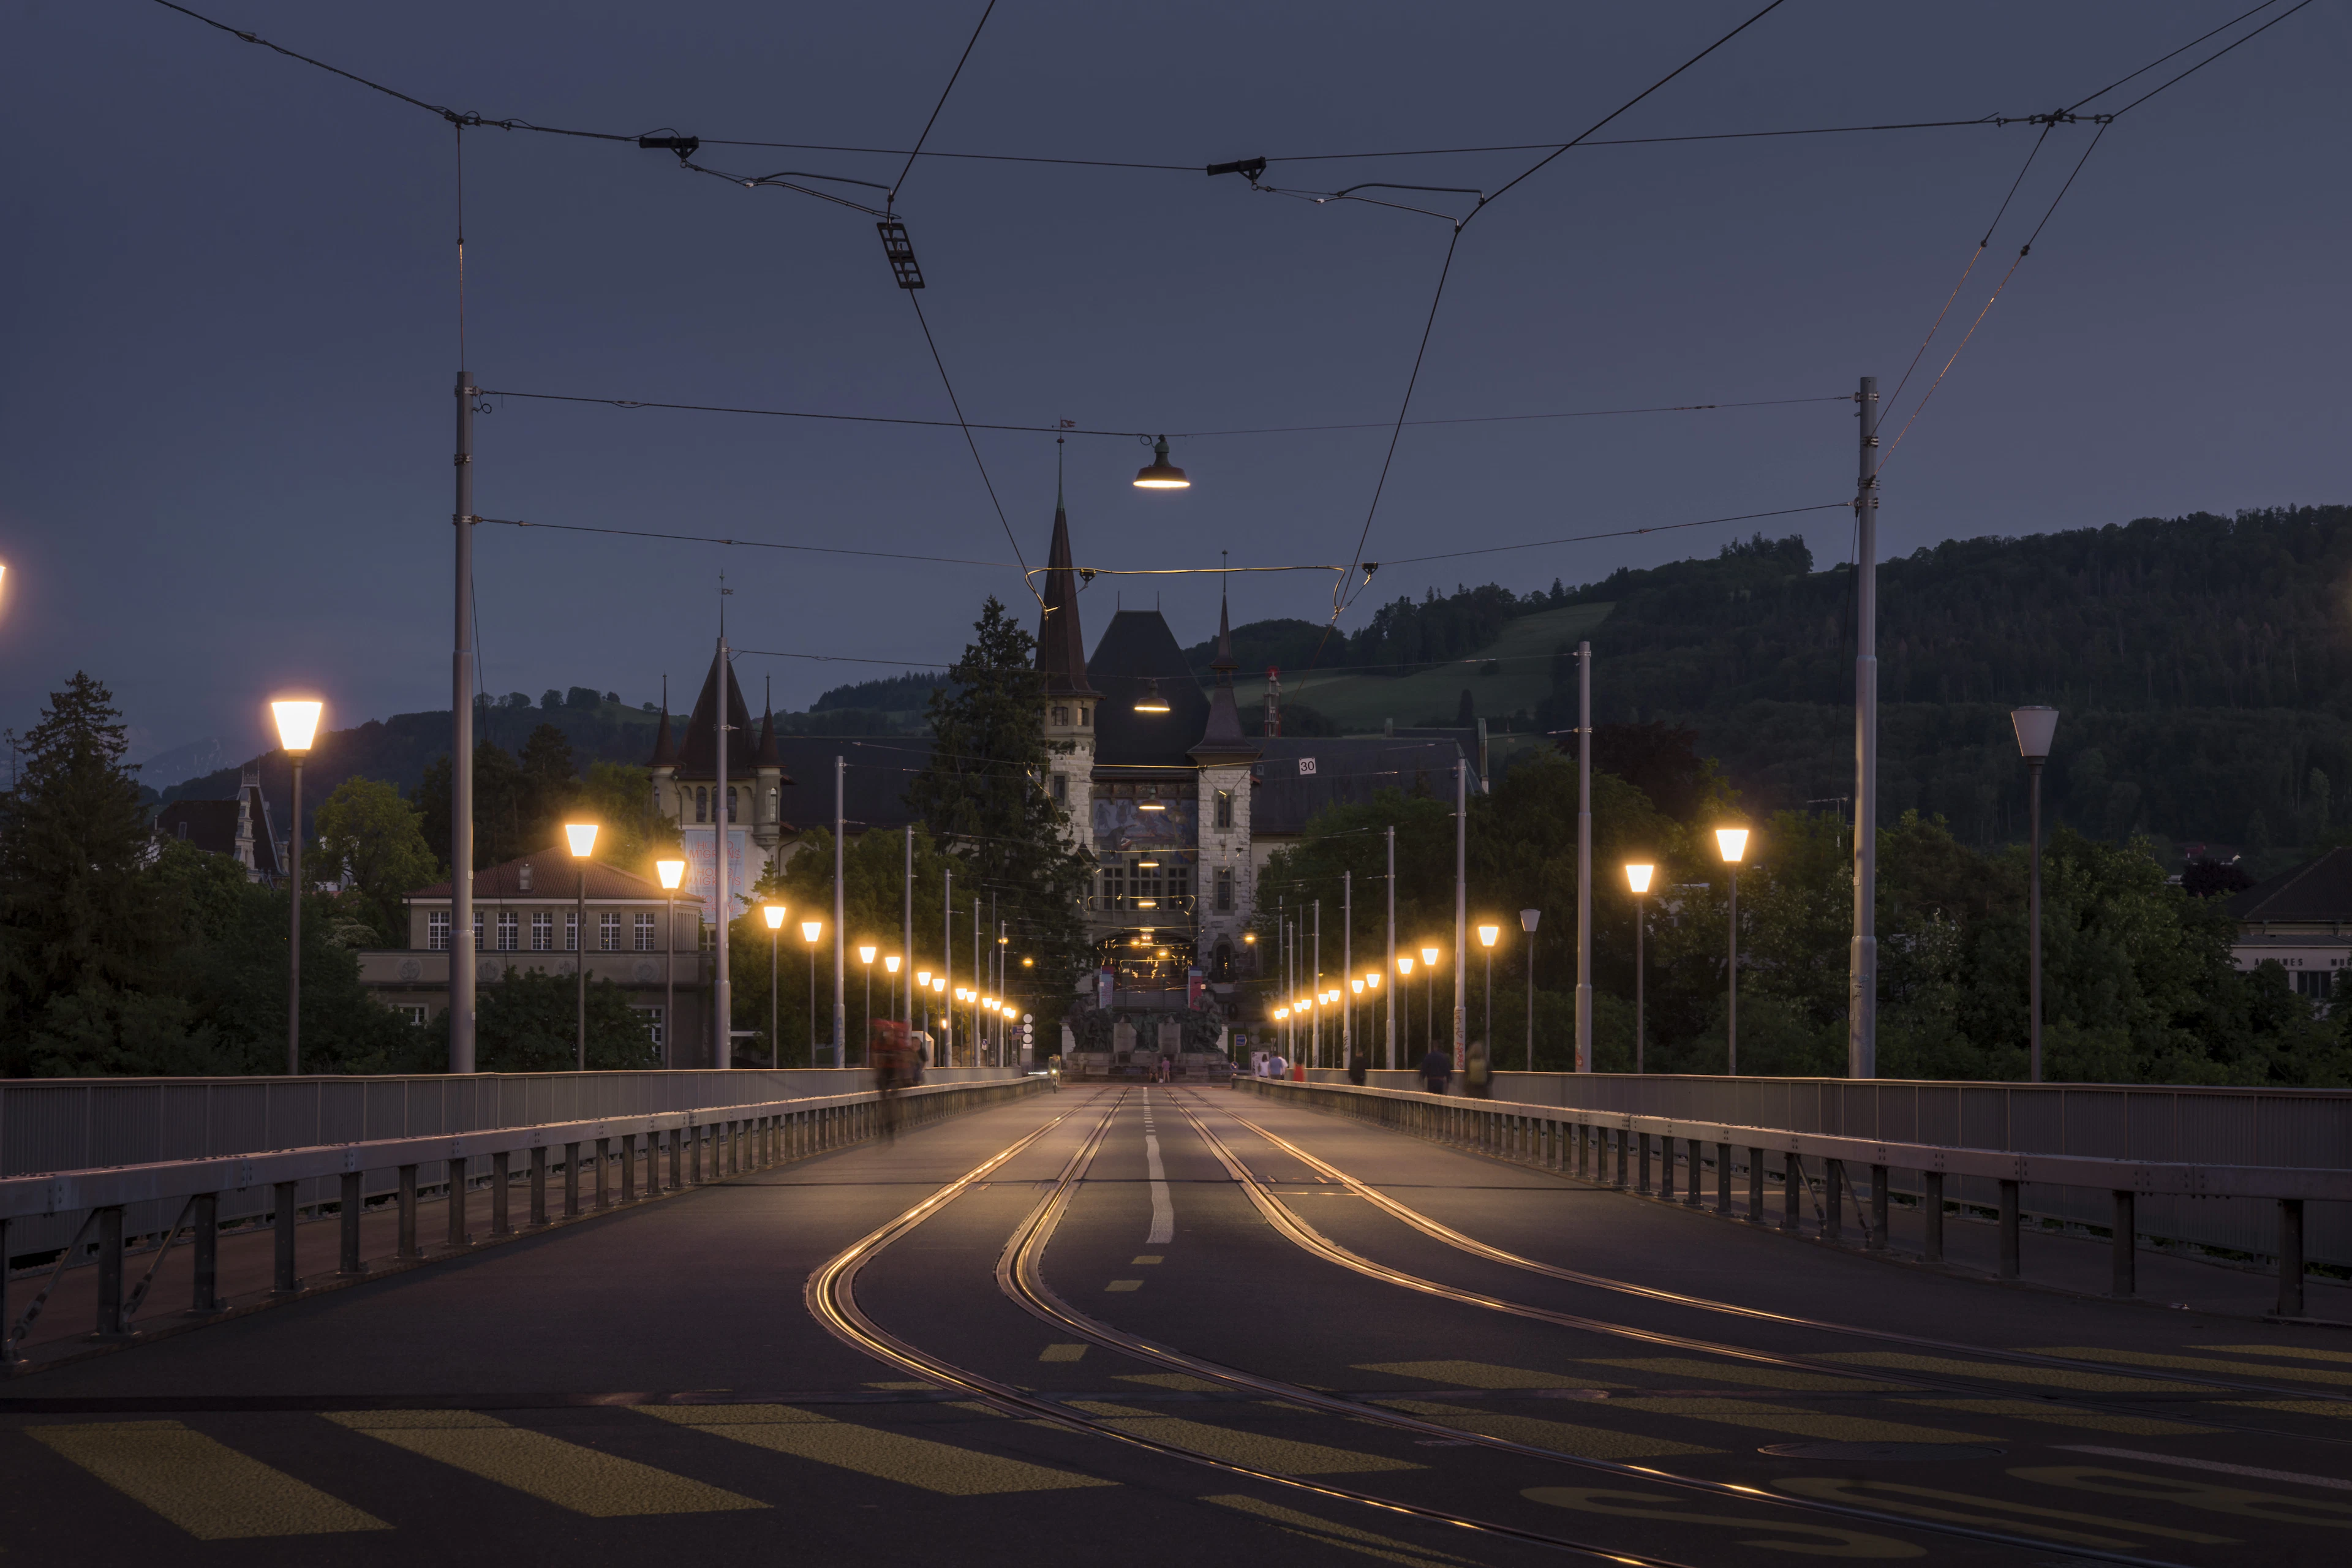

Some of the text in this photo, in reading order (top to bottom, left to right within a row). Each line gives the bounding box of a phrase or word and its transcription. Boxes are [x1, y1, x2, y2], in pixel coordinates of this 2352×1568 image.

[1300, 761, 1314, 772] 30
[697, 841, 734, 850] HOO
[697, 868, 733, 876] HOO
